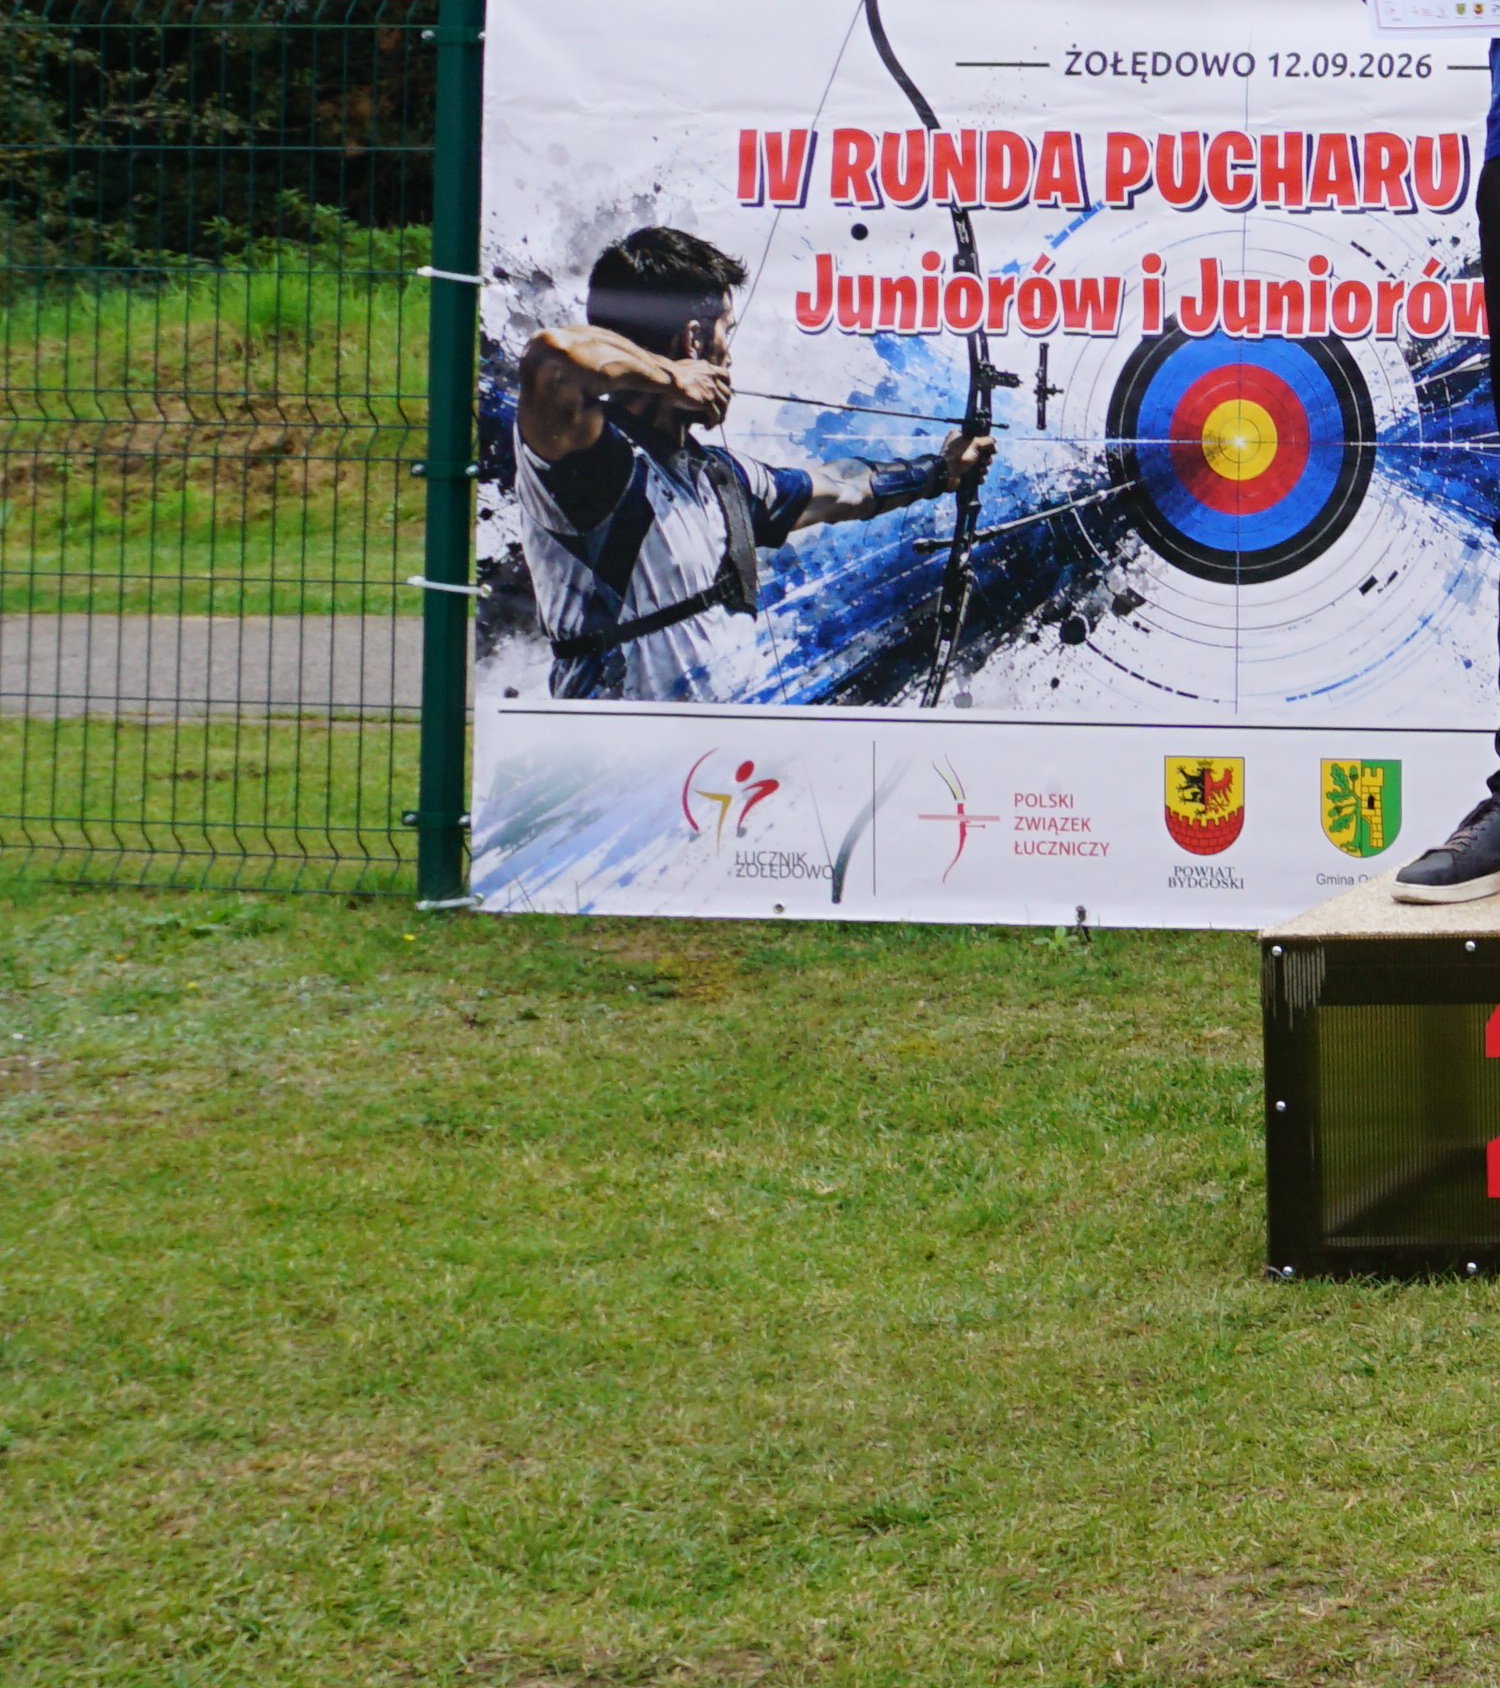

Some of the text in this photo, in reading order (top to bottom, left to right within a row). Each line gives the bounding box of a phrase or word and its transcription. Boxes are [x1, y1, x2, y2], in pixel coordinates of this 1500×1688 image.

[1064, 41, 1433, 84] ŻOŁĘDOWO 12.09.2026
[736, 125, 1470, 216] IV RUNDA PUCHARU
[795, 250, 1126, 338] Juniorów
[1141, 252, 1174, 339] i
[1014, 792, 1074, 808] POLSKI
[1013, 816, 1092, 835] ZWIĄZEK
[1013, 840, 1110, 857] ŁUCZNICZY
[735, 851, 808, 865] ŁUCZNIK
[1173, 865, 1236, 878] POWIAT
[1316, 873, 1355, 886] Gmina
[1167, 876, 1245, 889] BYDGOSKI
